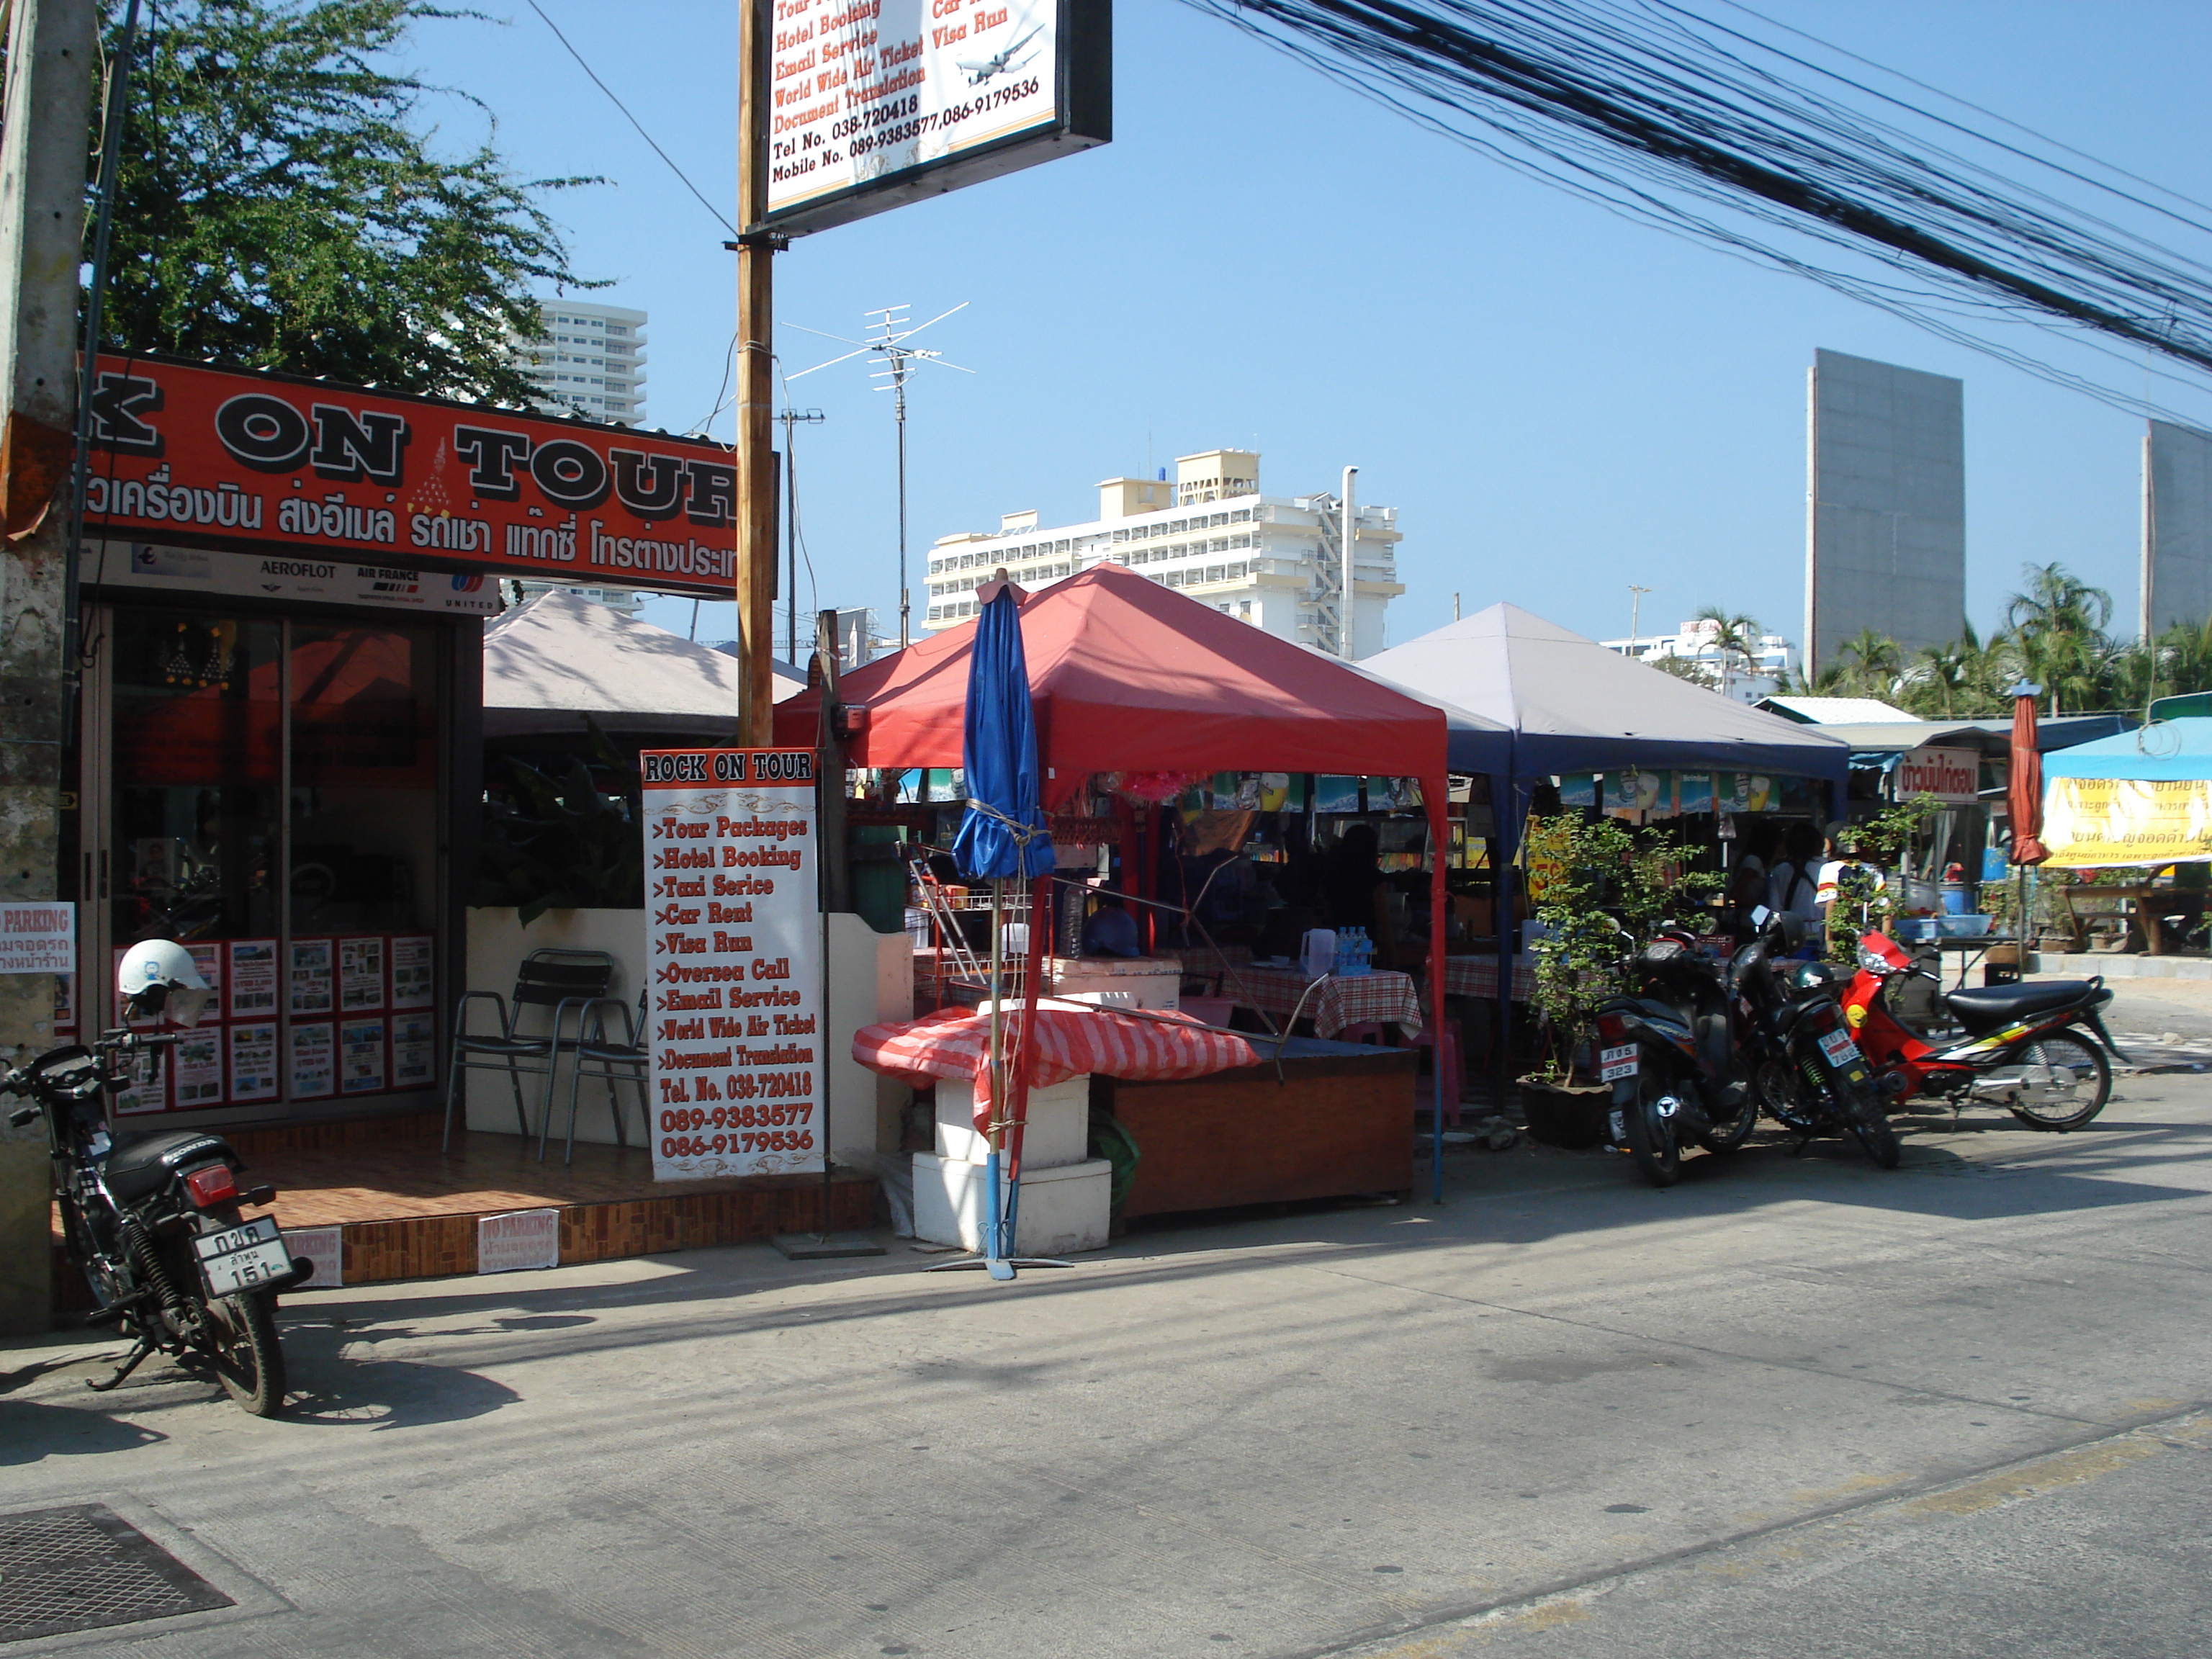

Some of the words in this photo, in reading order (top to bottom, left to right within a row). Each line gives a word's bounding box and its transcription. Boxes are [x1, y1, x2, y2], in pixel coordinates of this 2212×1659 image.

[775, 20, 814, 53] Hotel
[819, 1, 881, 35] Booking
[932, 23, 967, 50] Visa
[974, 6, 1007, 34] Run
[775, 48, 815, 81] Email
[822, 27, 878, 63] Service
[774, 78, 811, 109] World
[817, 66, 848, 102] Wide
[853, 55, 875, 80] Air
[880, 35, 924, 71] Ticket
[773, 99, 840, 135] Document
[845, 65, 926, 109] Translation
[773, 136, 797, 161] Tel
[801, 132, 826, 153] No.
[832, 94, 919, 140] 038-720418
[772, 154, 817, 183] Mobile
[822, 147, 844, 168] No.
[215, 392, 409, 485] ON
[454, 423, 737, 526] TOUR
[278, 480, 396, 544] ส่งอีเมล์
[410, 500, 491, 553] รถเช่า
[261, 560, 336, 579] AEROFLOT
[358, 567, 376, 579] AIR
[378, 569, 419, 582] FRANCE
[446, 599, 494, 610] UNITED
[644, 753, 707, 782] ROCK
[714, 753, 746, 781] ON
[752, 752, 813, 780] TOUR
[716, 816, 808, 841] Packages
[722, 845, 801, 871] Booking
[713, 873, 774, 896] Serice
[4, 909, 68, 933] PARKING
[708, 902, 752, 924] Rent
[714, 930, 752, 953] Run
[752, 958, 790, 980] Call
[729, 985, 801, 1008] Service
[709, 1016, 742, 1038] Wide
[747, 1015, 769, 1036] Air
[773, 1013, 816, 1035] Ticket
[736, 1043, 814, 1066] Translation
[1607, 1064, 1632, 1078] 323
[660, 1077, 690, 1104] Tel.
[695, 1076, 722, 1102] No.
[727, 1071, 812, 1100] 038-720418
[660, 1102, 814, 1133] 089-9383577
[660, 1129, 814, 1159] 086-9179536
[483, 1219, 500, 1240] NO
[503, 1214, 553, 1238] PARKING
[230, 1261, 272, 1287] 151
